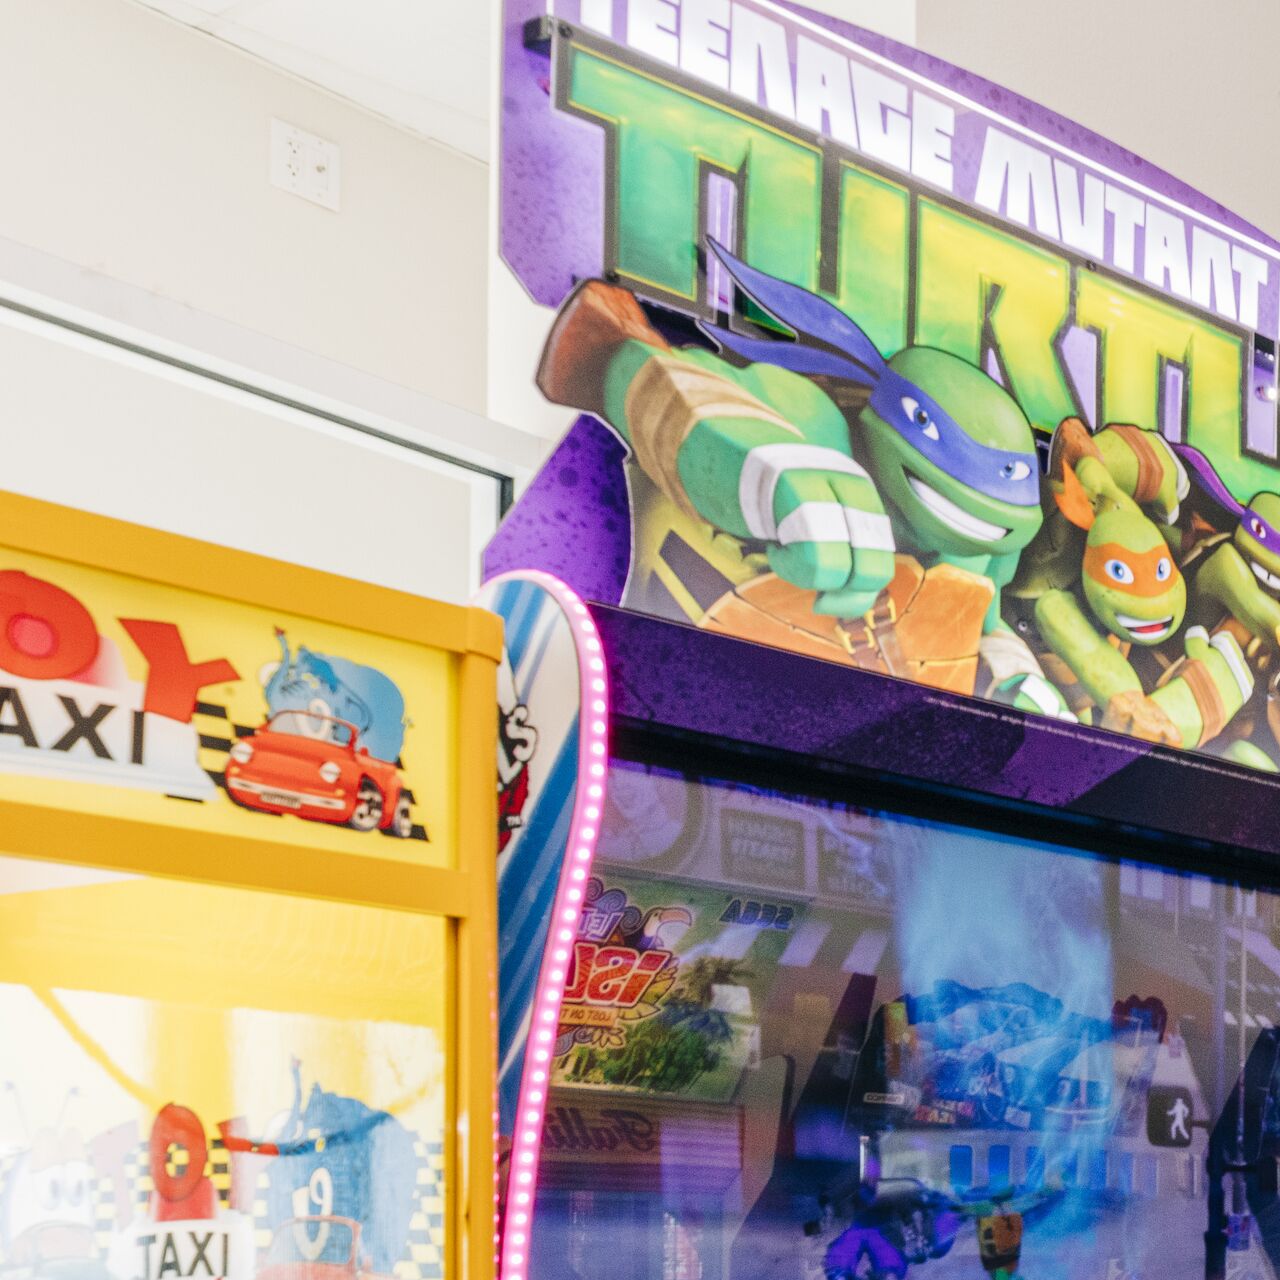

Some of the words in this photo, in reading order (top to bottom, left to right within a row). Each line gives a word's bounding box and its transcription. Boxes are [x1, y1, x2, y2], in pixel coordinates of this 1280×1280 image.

[974, 126, 1270, 340] MUTANT
[0, 569, 241, 724] OY
[0, 685, 145, 765] AXI
